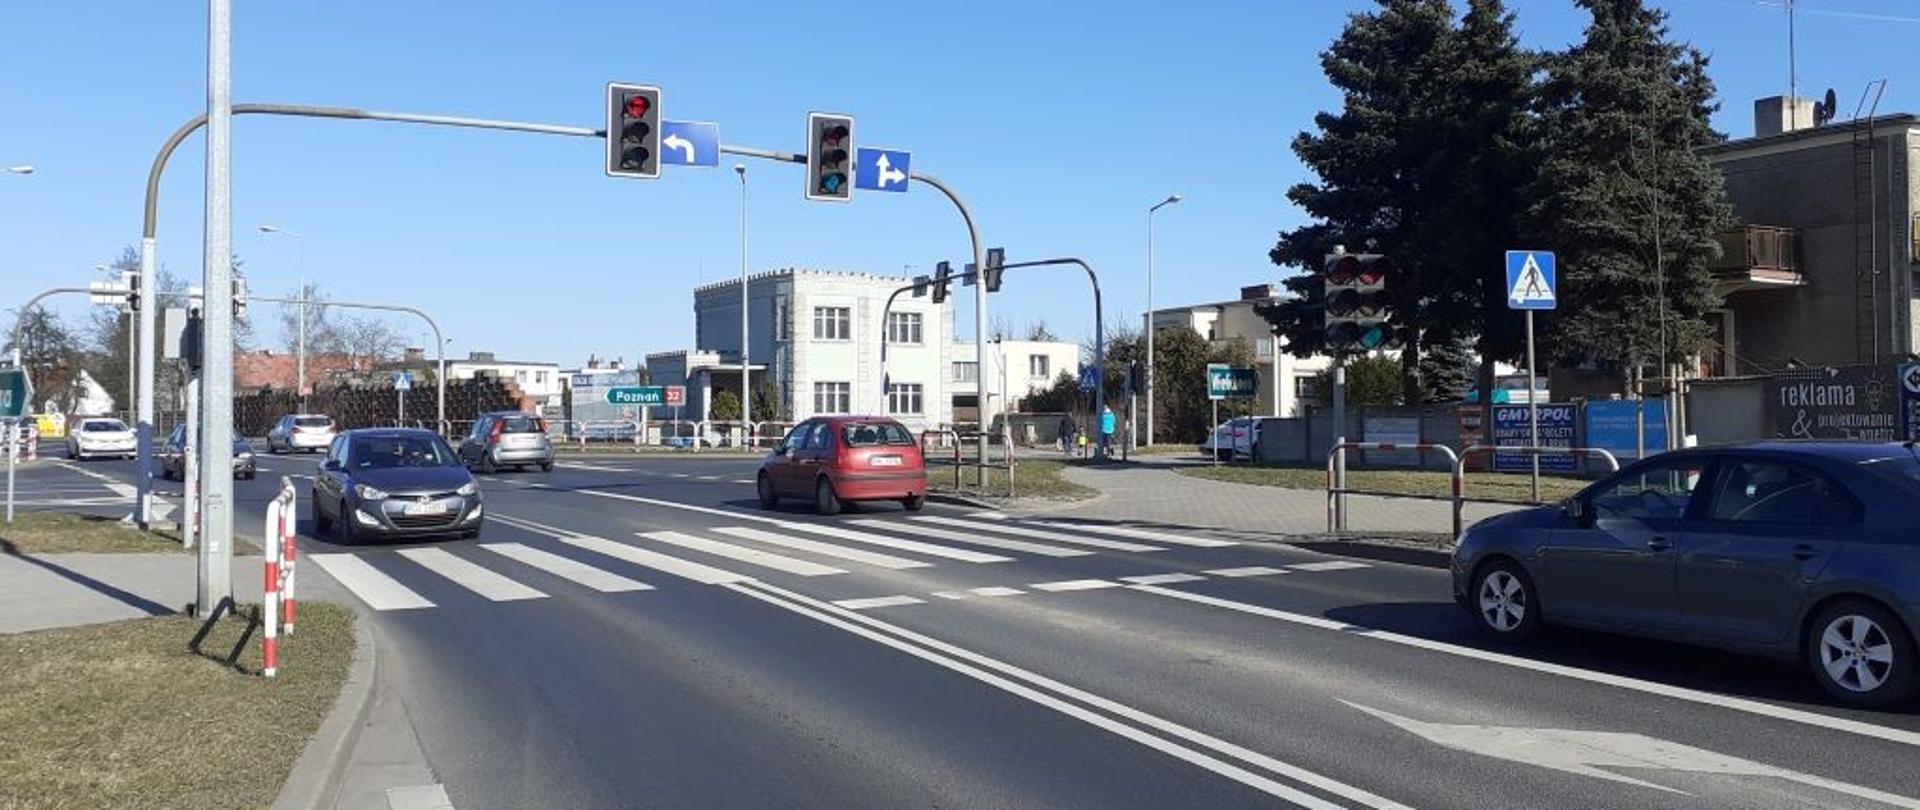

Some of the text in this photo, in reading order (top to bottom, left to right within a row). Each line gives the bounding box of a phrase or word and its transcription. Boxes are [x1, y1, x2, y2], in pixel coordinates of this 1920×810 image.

[616, 389, 680, 402] Poznań 32
[1780, 382, 1855, 406] reklama
[1791, 409, 1814, 439] &
[1818, 413, 1894, 428] projektowanie
